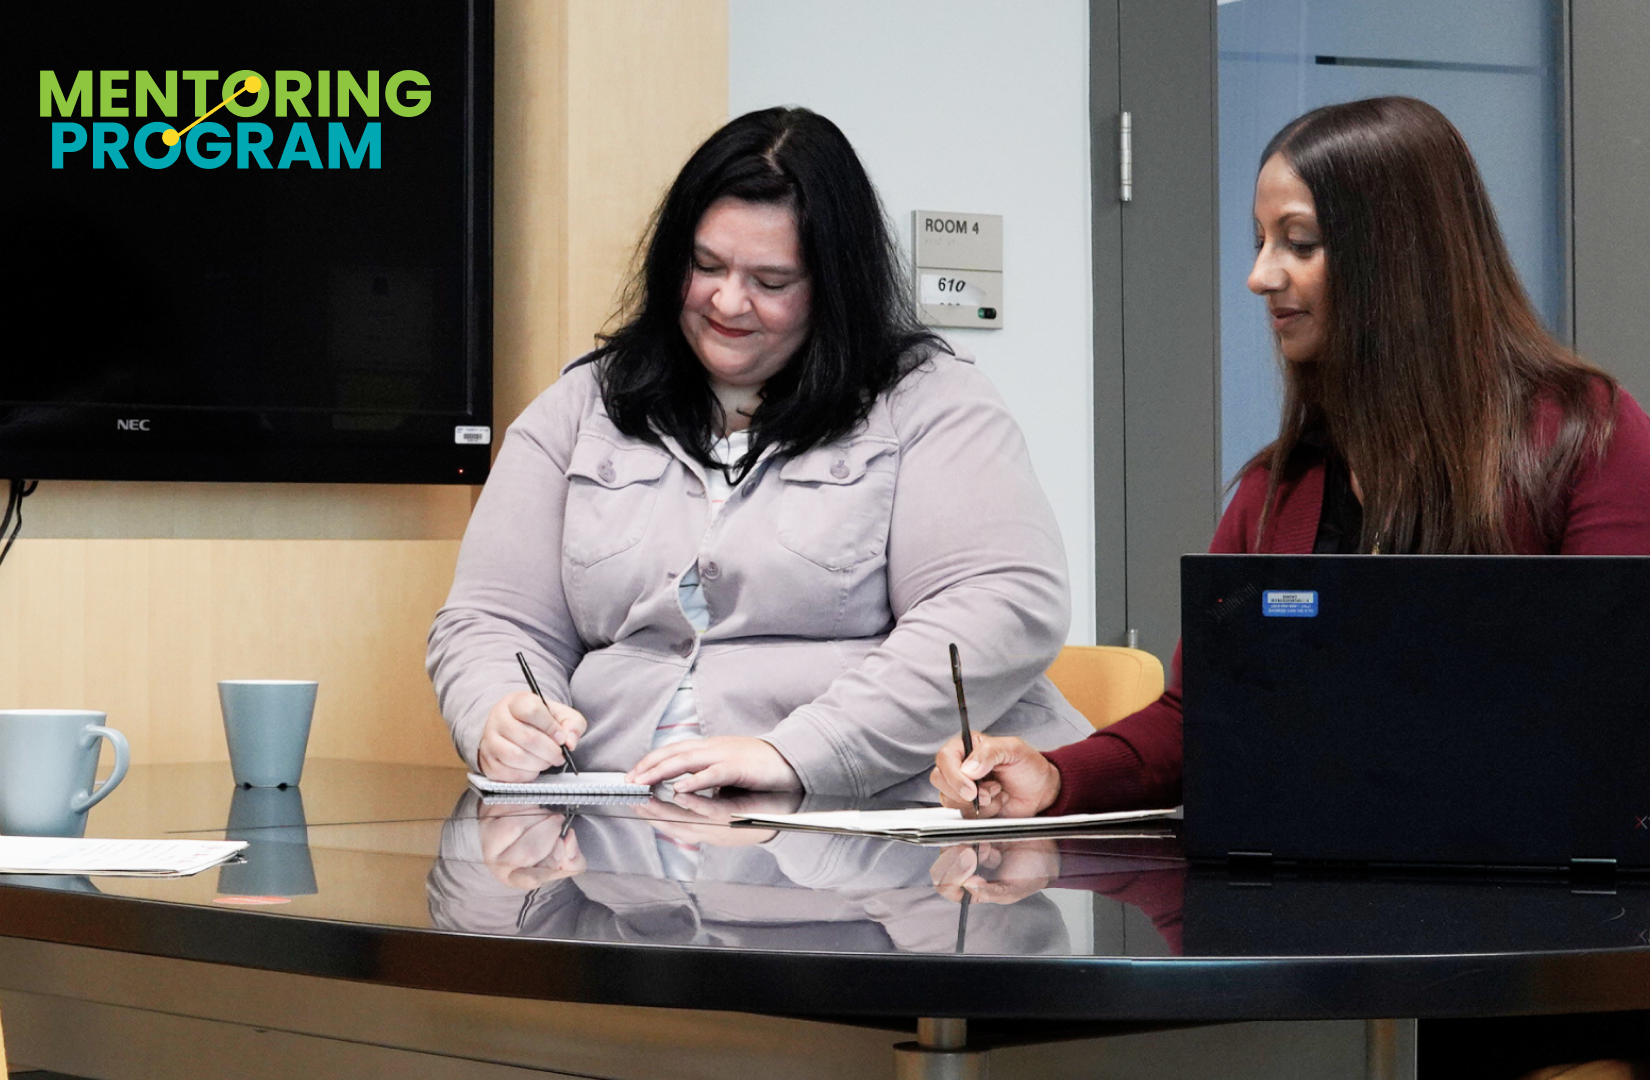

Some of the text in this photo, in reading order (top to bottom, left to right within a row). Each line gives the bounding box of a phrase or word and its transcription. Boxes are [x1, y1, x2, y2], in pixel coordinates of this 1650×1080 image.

[925, 218, 979, 234] ROOM 4
[938, 277, 966, 292] 610
[117, 419, 151, 431] NEC
